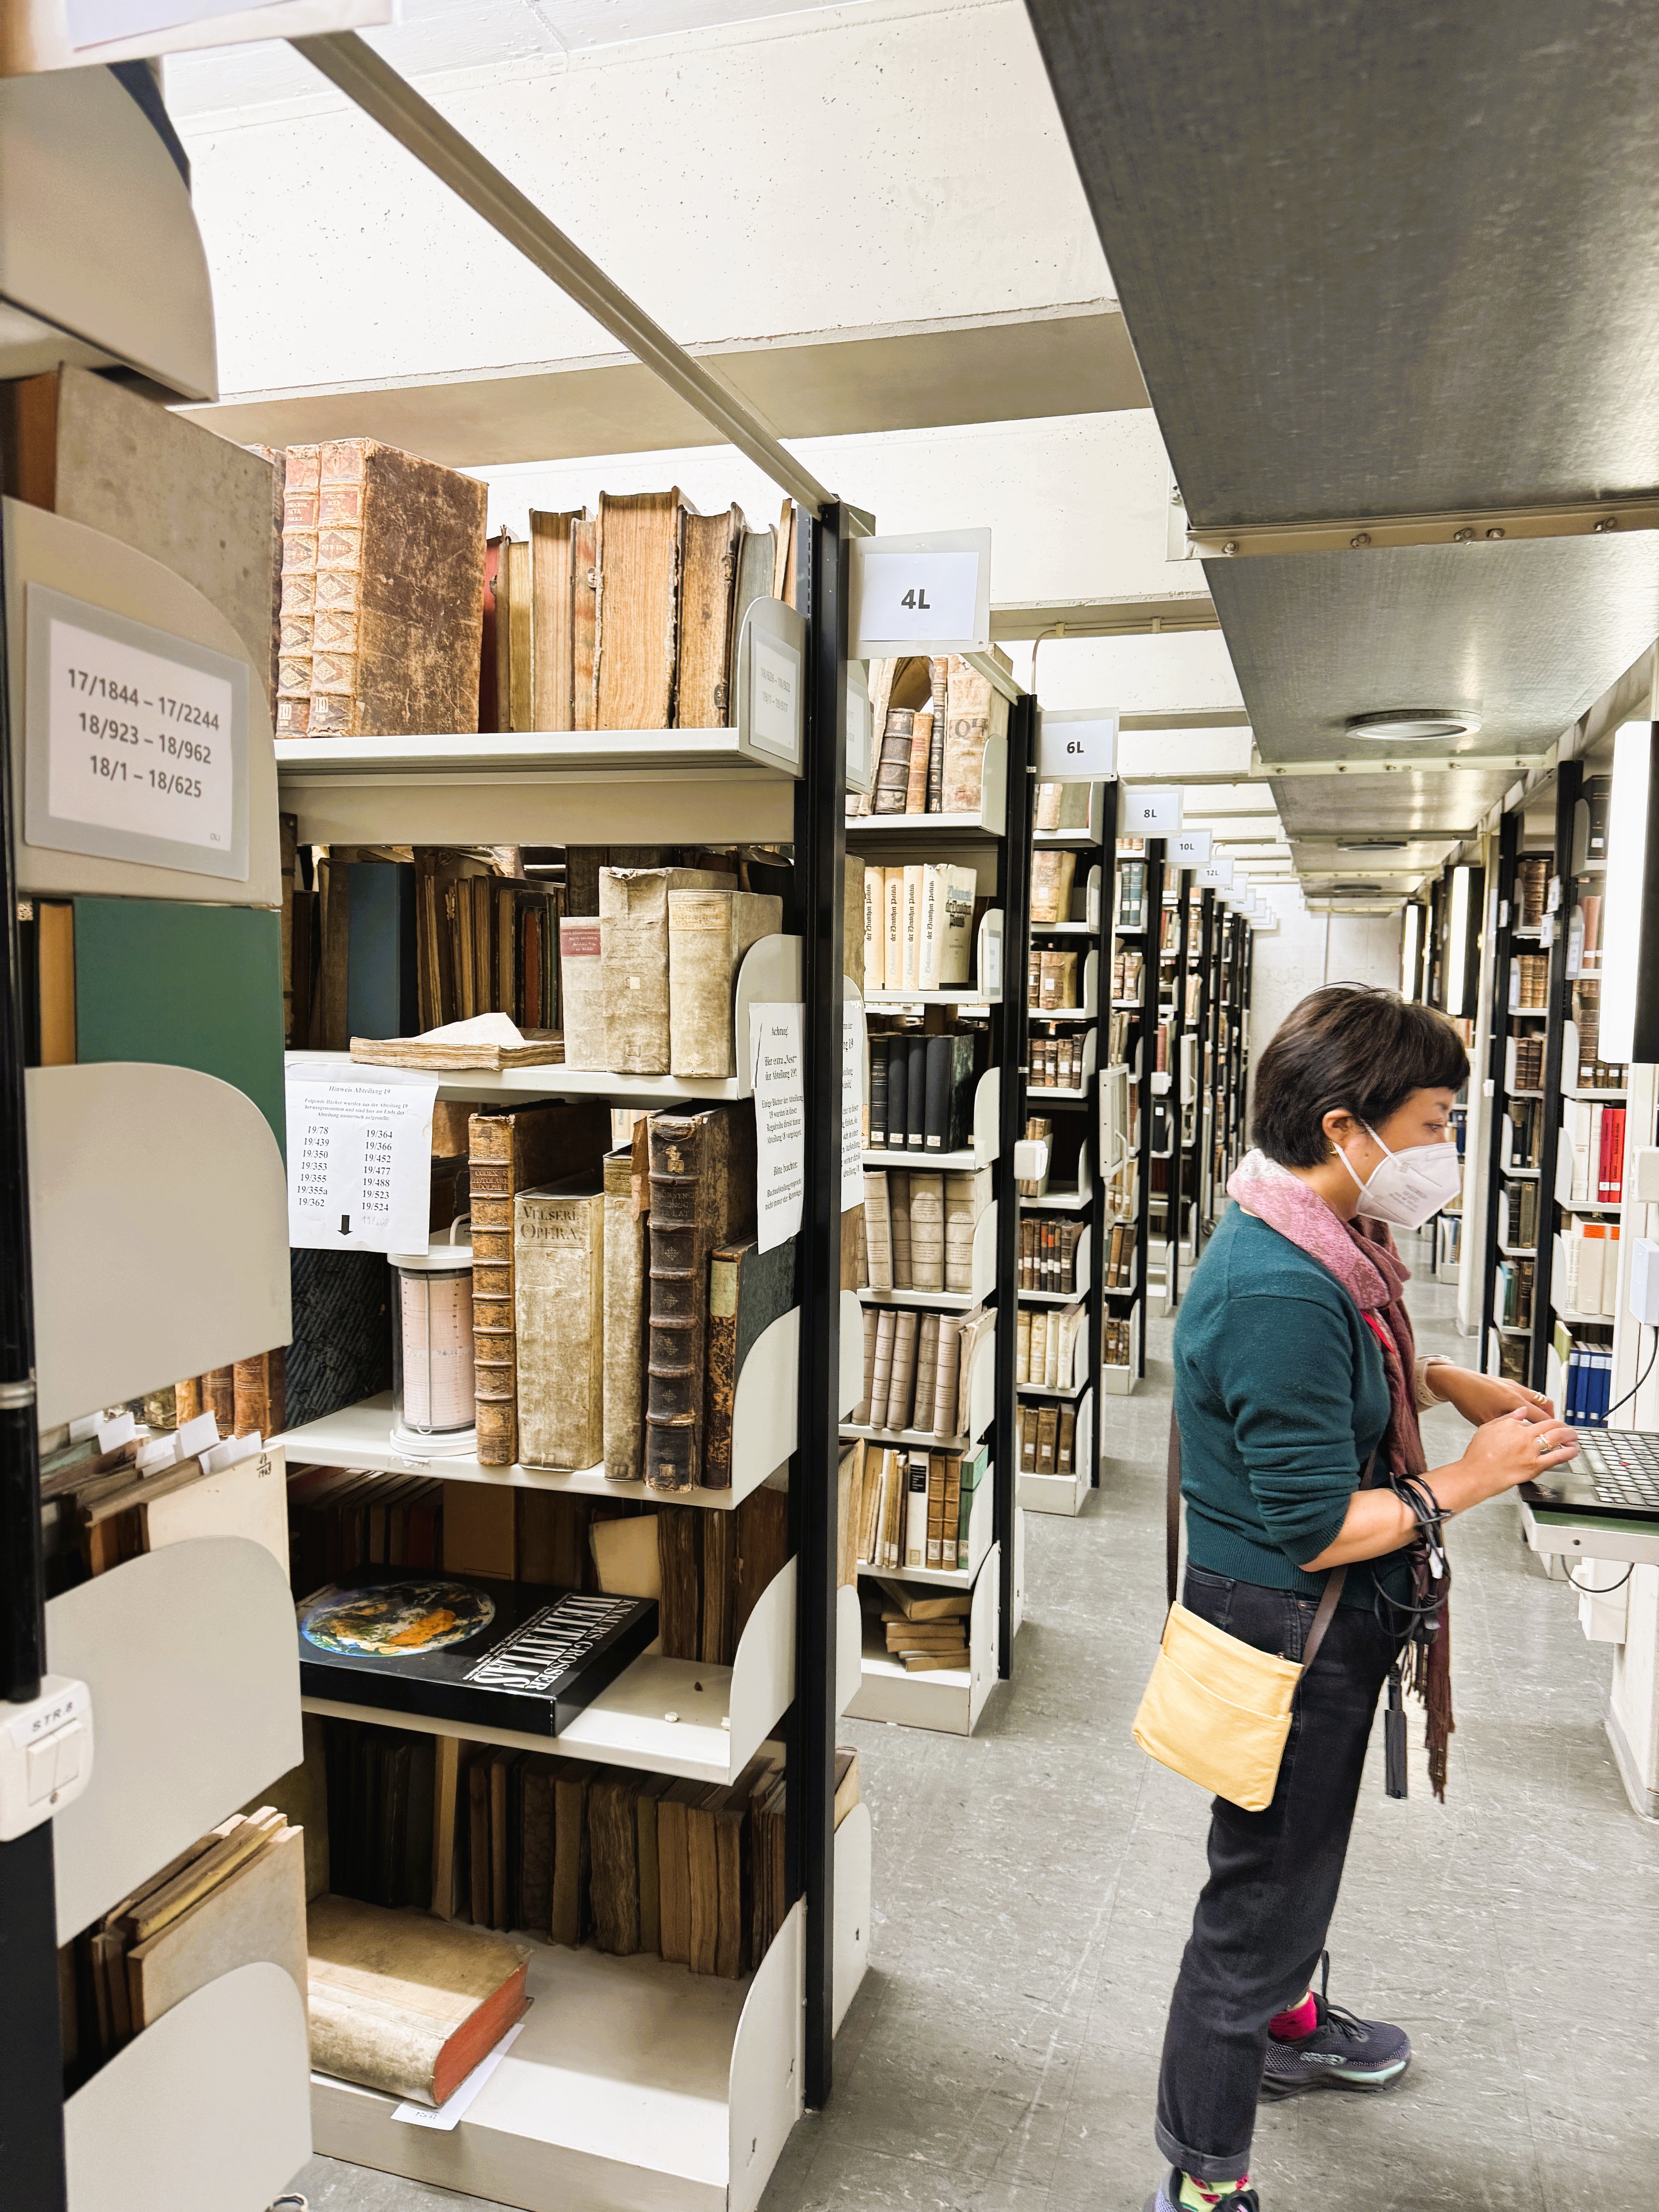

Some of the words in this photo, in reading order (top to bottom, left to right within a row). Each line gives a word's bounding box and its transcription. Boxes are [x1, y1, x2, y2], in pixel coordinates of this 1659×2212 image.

[901, 589, 930, 610] 4L
[67, 668, 139, 707] 17/1844
[160, 697, 219, 730] 17/2244
[79, 712, 139, 745] 18/923
[160, 734, 212, 764] 18/962
[1066, 741, 1084, 754] 6L
[90, 756, 128, 781] 18/1
[149, 769, 202, 798] 18/625
[1144, 809, 1157, 818] 8L
[771, 1027, 788, 1037] Achtung!
[773, 1070, 790, 1080] Abteilung
[308, 1126, 328, 1134] 19/78
[367, 1130, 392, 1138] 19/364
[304, 1138, 329, 1146] 19/439
[366, 1142, 392, 1150] 19/366
[303, 1150, 328, 1158] 19/350
[365, 1154, 390, 1163] 19/452
[302, 1162, 327, 1171] 19/353
[364, 1166, 390, 1175] 19/477
[774, 1166, 782, 1175] Bitte
[301, 1174, 326, 1182] 19/355
[364, 1178, 390, 1187] 19/488
[297, 1186, 328, 1195] 19/355a
[363, 1190, 389, 1199] 19/523
[299, 1198, 324, 1206] 19/362
[362, 1202, 388, 1211] 19/524
[585, 1599, 639, 1640] KNAURS
[474, 1595, 623, 1689] WELTATLAS
[524, 1641, 594, 1690] GROSSER
